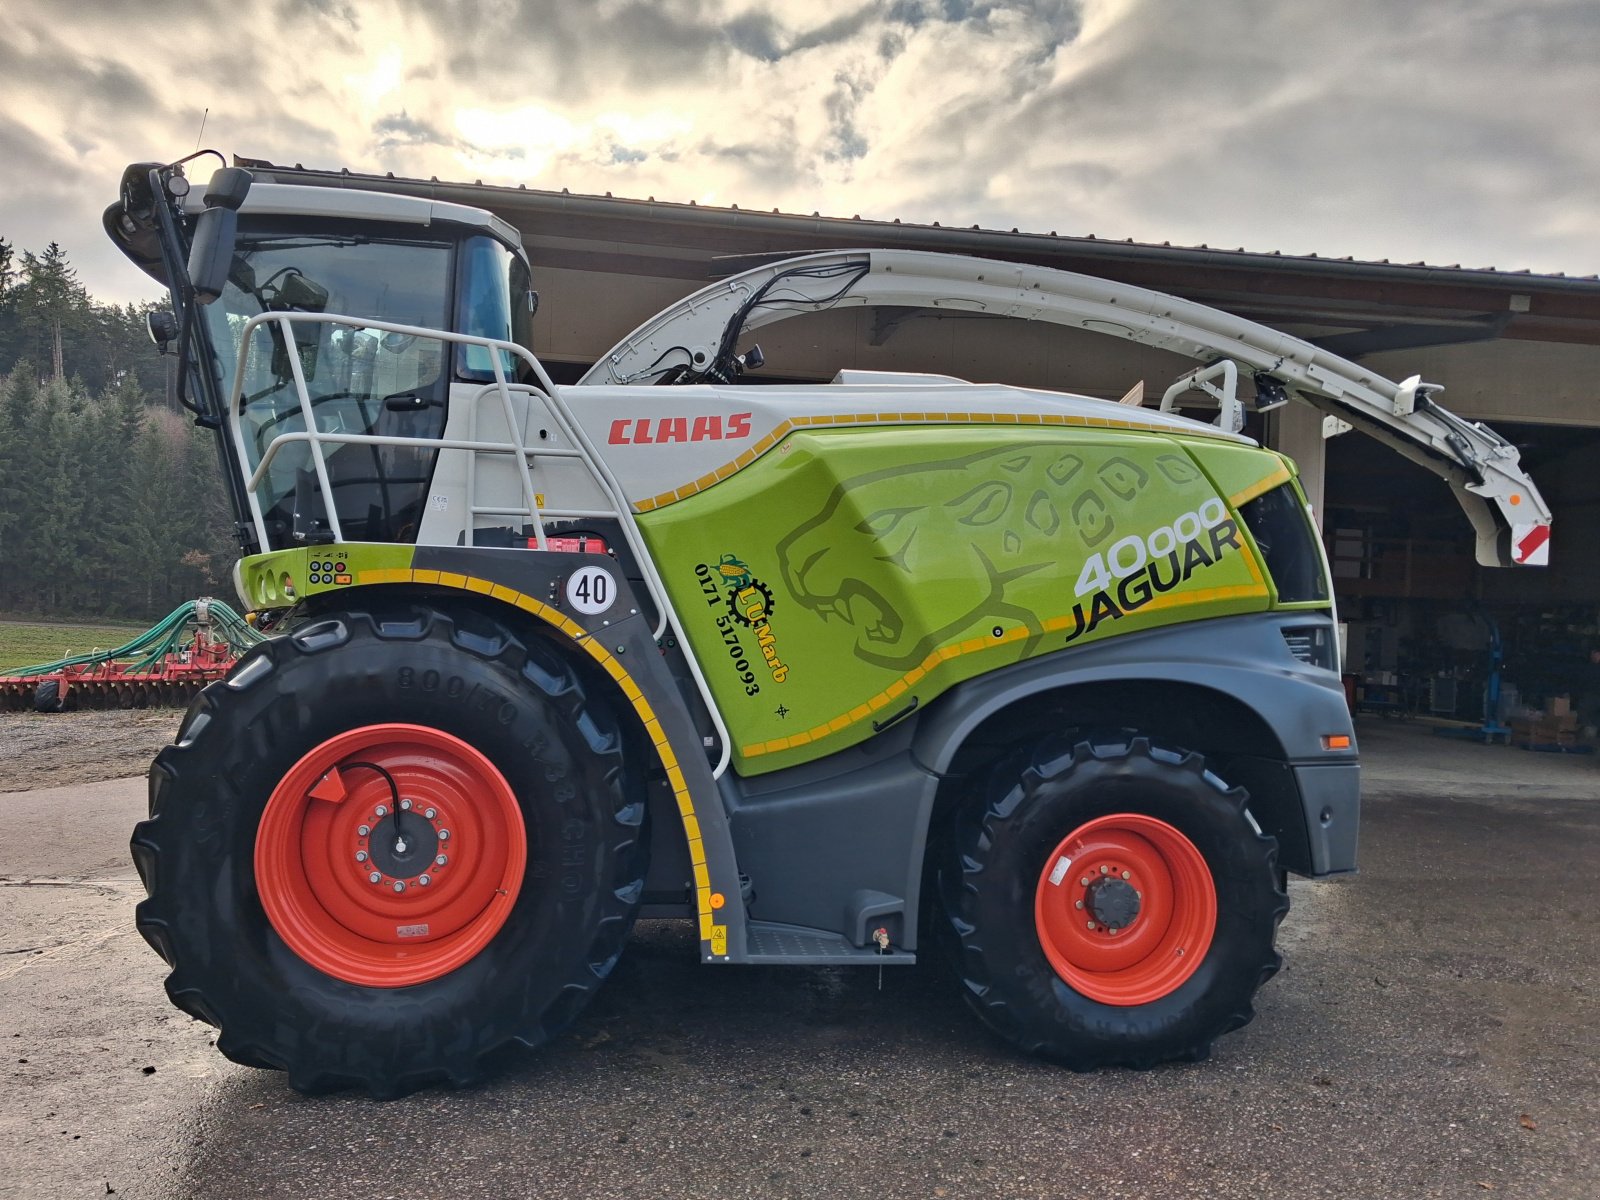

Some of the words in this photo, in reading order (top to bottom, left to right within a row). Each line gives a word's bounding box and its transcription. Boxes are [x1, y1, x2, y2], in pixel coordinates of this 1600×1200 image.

[608, 413, 752, 445] CLAAS
[1066, 518, 1242, 643] JAGUAR
[1074, 497, 1226, 598] 40000
[575, 574, 607, 605] 40
[694, 563, 722, 608] 0171
[716, 615, 760, 697] 5170093
[399, 666, 519, 726] 800/70
